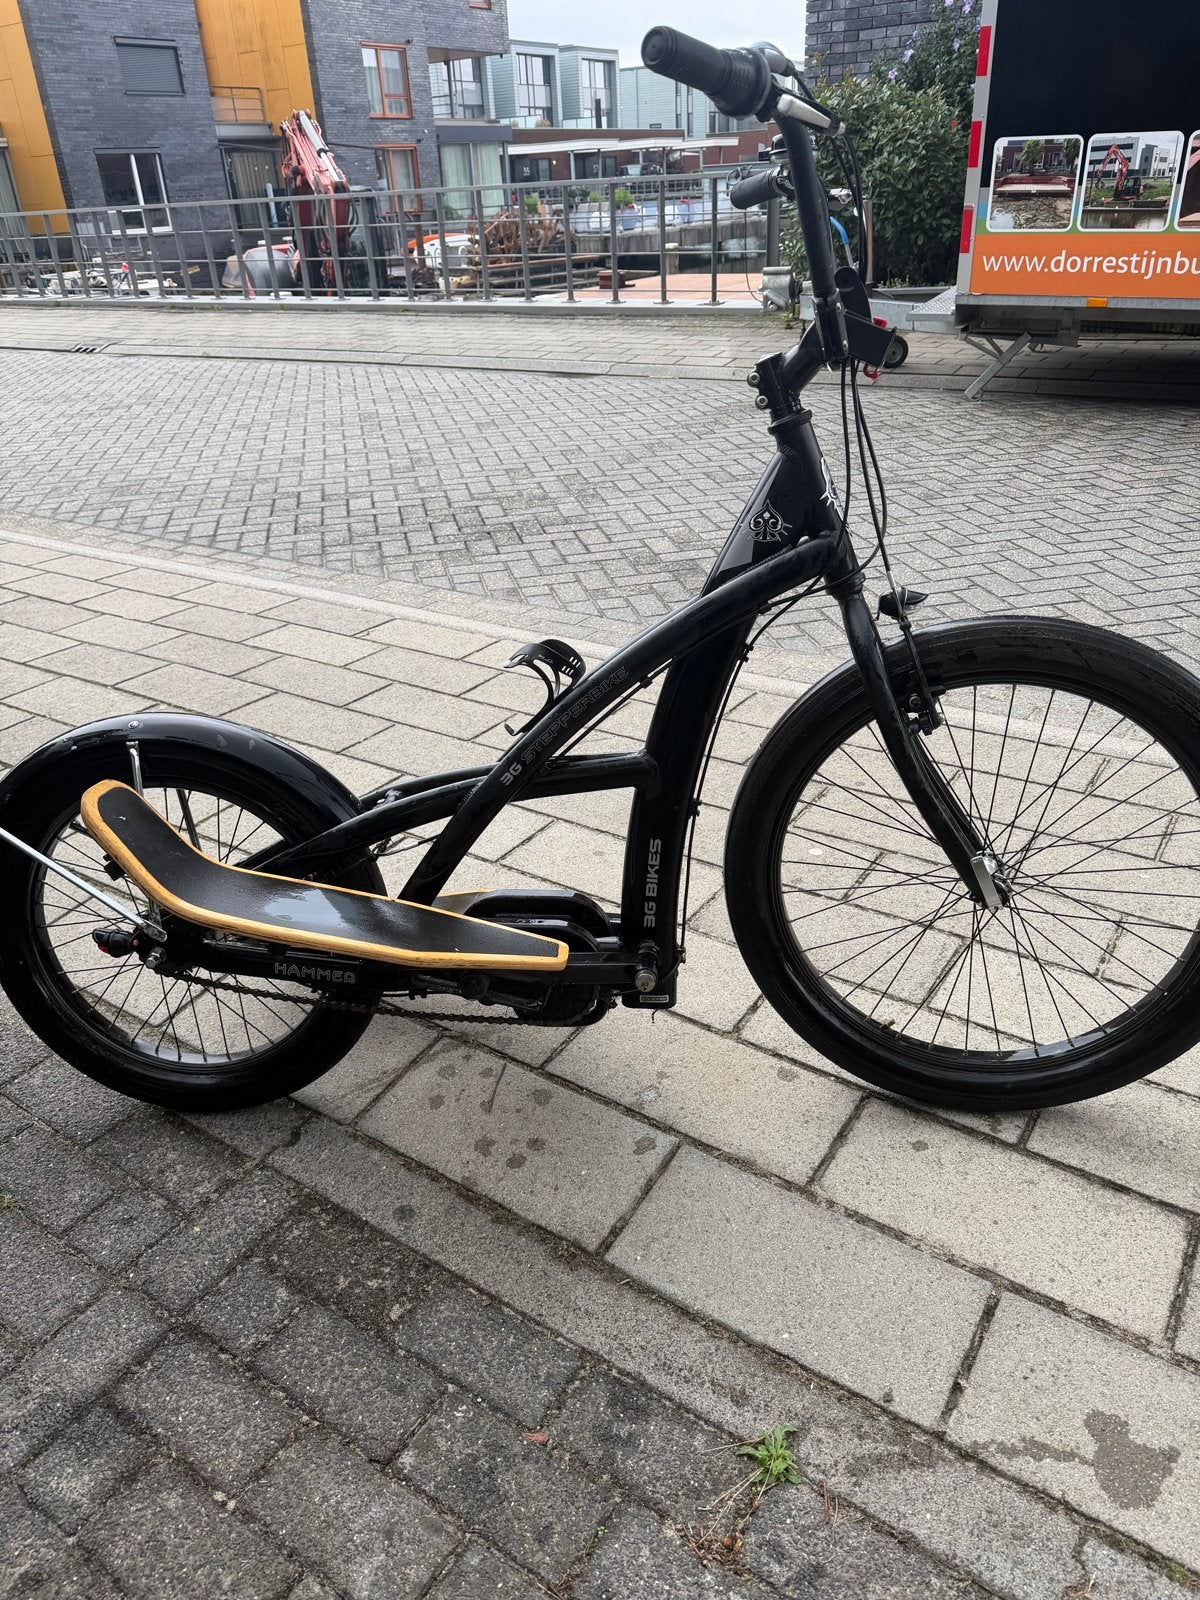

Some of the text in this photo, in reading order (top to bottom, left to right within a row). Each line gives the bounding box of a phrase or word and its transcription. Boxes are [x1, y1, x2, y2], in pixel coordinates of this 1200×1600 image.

[523, 167, 530, 176] 35
[500, 665, 629, 786] 3G STEPPERBIKE
[643, 838, 662, 928] 3G BIKES
[274, 962, 357, 984] HAMMER
